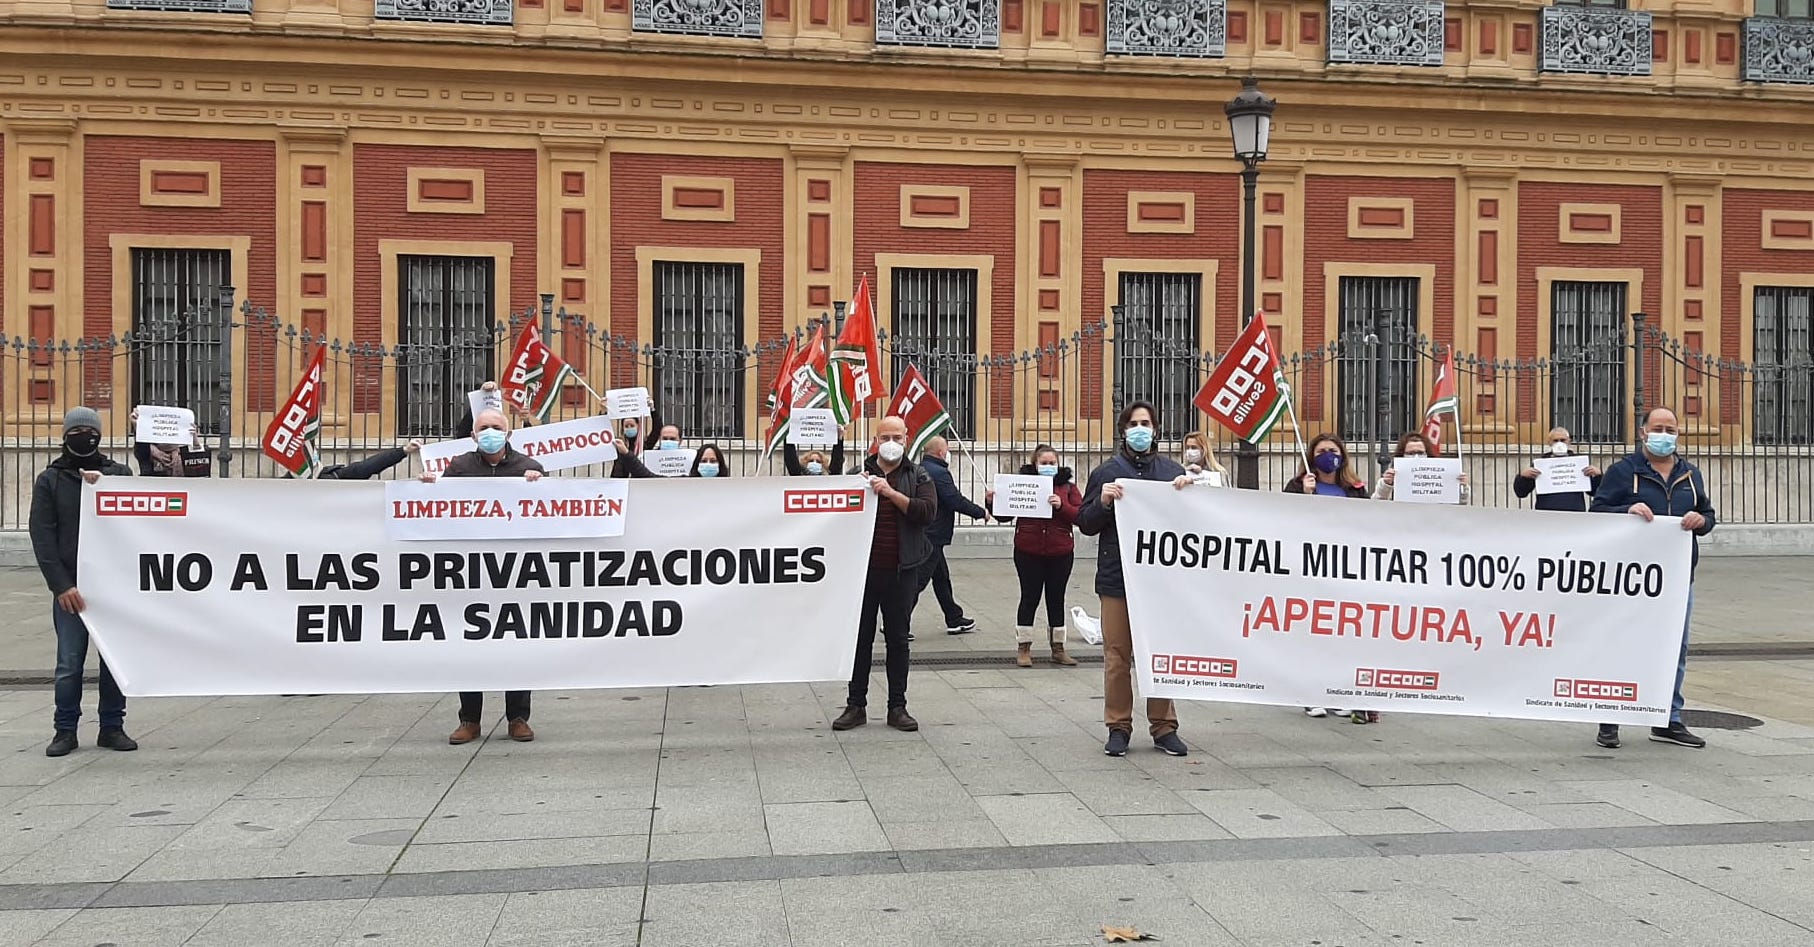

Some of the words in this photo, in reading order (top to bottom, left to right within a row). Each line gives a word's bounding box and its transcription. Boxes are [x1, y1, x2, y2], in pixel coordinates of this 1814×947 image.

[523, 430, 613, 457] TAMPOCO
[99, 495, 167, 512] CCOO
[393, 499, 512, 522] LIMPIEZA,
[519, 494, 624, 519] TAMBIÉN
[788, 493, 848, 509] CCOO
[139, 552, 213, 591] NO
[230, 553, 268, 591] A
[286, 553, 380, 590] LAS
[399, 546, 827, 590] PRIVATIZACIONES
[1135, 529, 1290, 575] HOSPITAL
[1302, 542, 1428, 585] MILITAR
[1441, 552, 1526, 591] 100%
[1537, 550, 1664, 598] PÚBLICO
[296, 604, 363, 642] EN
[382, 603, 446, 641] LA
[464, 599, 683, 640] SANIDAD
[1241, 596, 1482, 651] ¡APERTURA,
[1498, 610, 1556, 648] YA!
[1175, 659, 1222, 673] CCOO
[1161, 677, 1185, 685] Sanidad
[1192, 679, 1217, 687] Sectores
[1379, 673, 1425, 686] CCOO
[1326, 688, 1353, 696] Sindicato
[1364, 690, 1388, 698] Sanidad
[1394, 691, 1419, 699] Sectores
[1577, 683, 1623, 697] CCOO
[1525, 698, 1553, 707] Sindicato
[1564, 701, 1588, 709] Sanidad
[1594, 702, 1619, 710] Sectores
